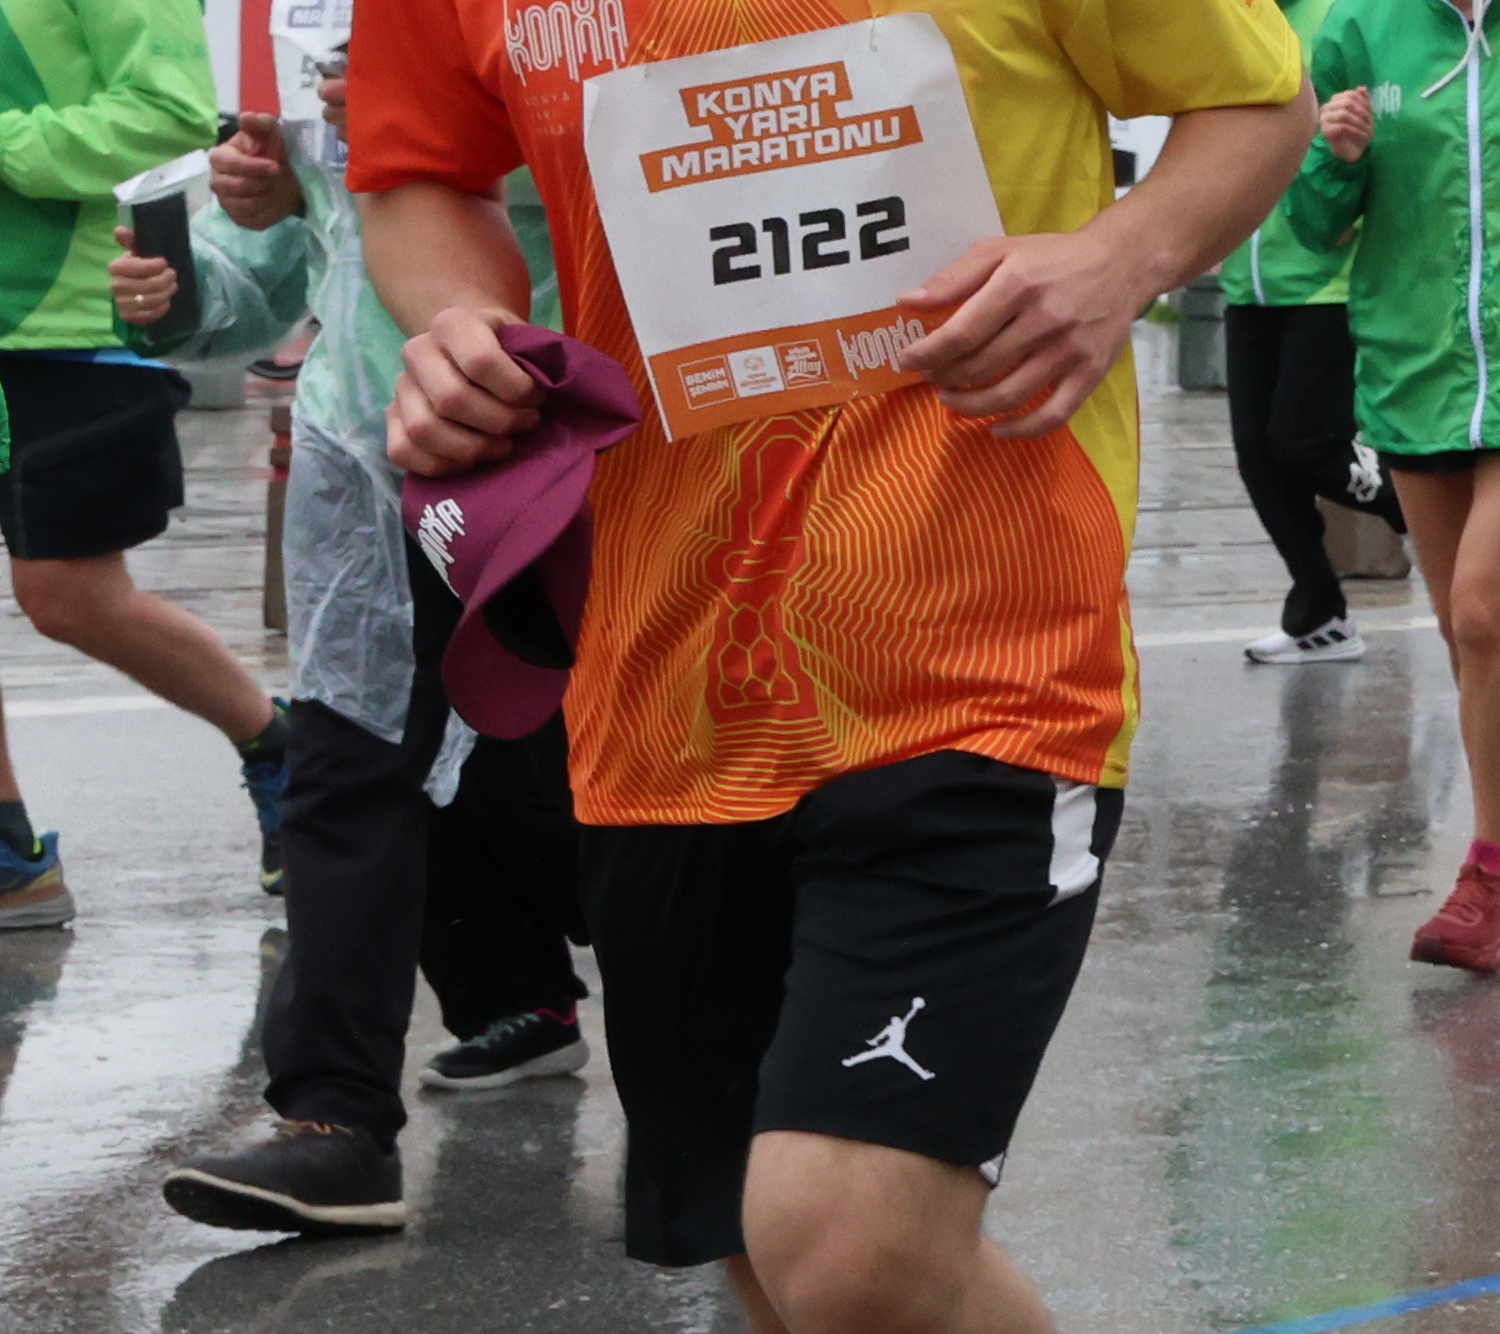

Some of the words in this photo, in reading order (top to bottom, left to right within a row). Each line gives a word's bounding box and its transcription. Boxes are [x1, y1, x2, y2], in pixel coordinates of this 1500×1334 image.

[696, 71, 836, 118] KONYA
[724, 101, 820, 140] YARI
[661, 116, 900, 182] MARATONU
[710, 196, 910, 285] 2122
